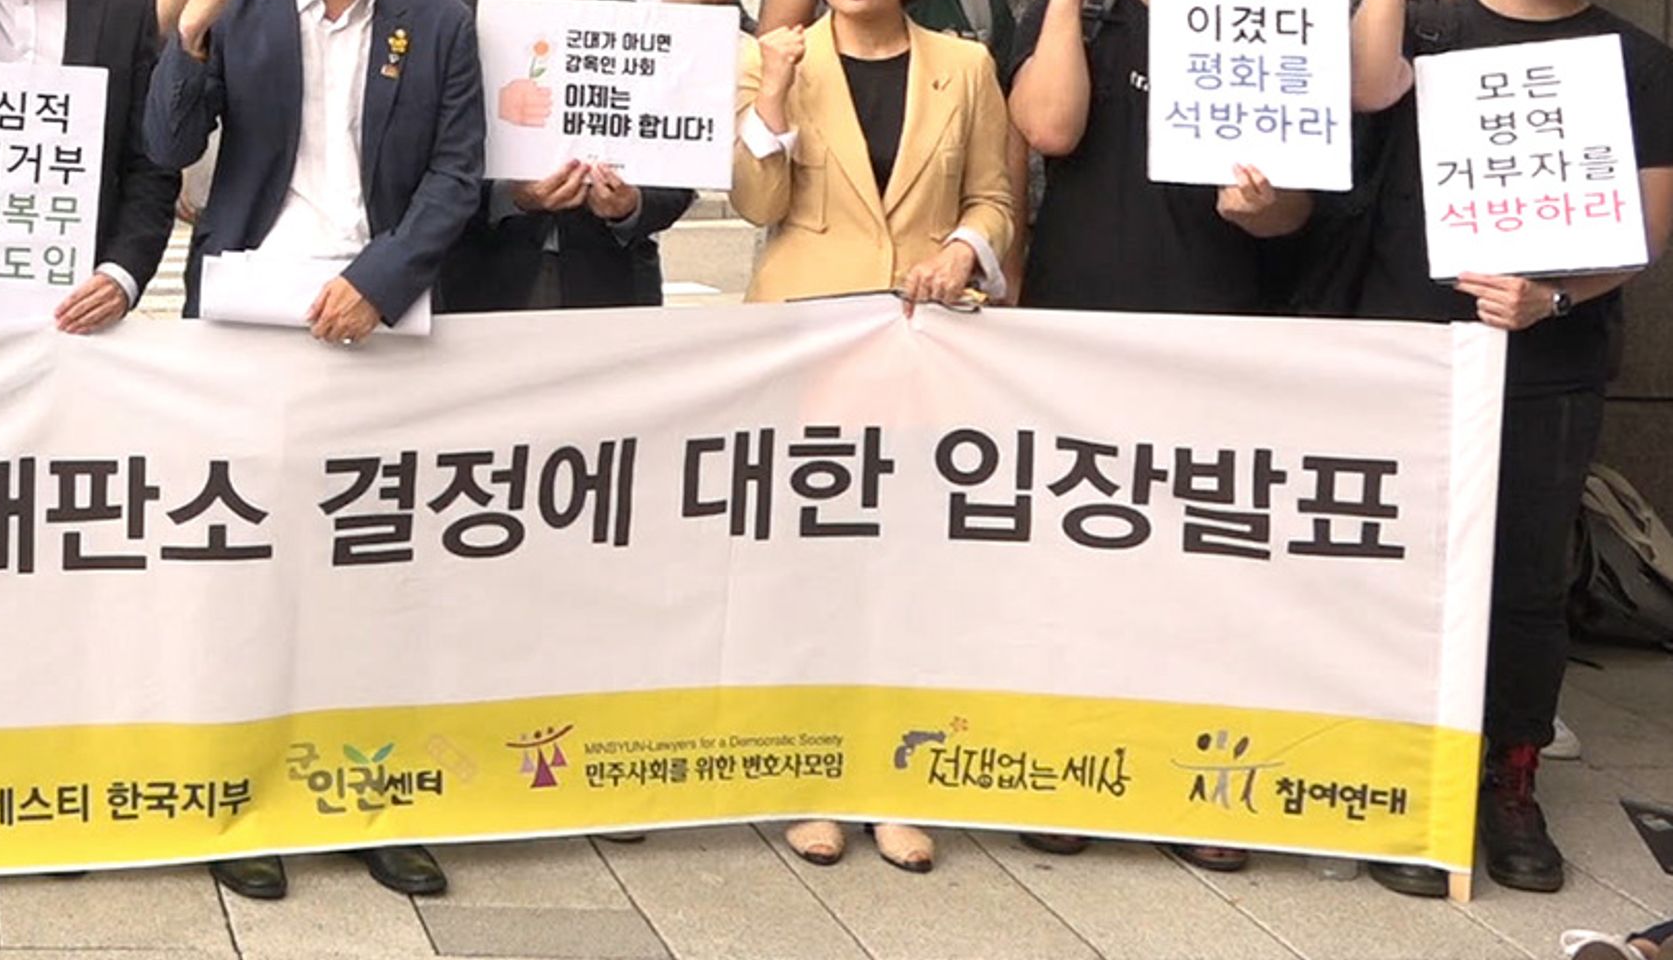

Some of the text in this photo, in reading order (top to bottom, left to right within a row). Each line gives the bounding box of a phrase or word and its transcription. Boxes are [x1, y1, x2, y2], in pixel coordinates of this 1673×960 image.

[566, 29, 671, 53] 군대가 아니면
[1187, 4, 1314, 45] 이겼다
[566, 54, 655, 76] 감옥인 사회
[1187, 52, 1313, 95] 평화를
[1476, 65, 1561, 100] 모든
[564, 83, 631, 110] 이제는
[562, 111, 714, 141] 바꿔야 합니다!
[1165, 101, 1338, 145] 석방하라
[1480, 107, 1565, 145] 병역
[1436, 145, 1618, 190] 거부자를
[1441, 189, 1626, 234] 석방하라
[318, 438, 637, 567] 결정에
[682, 426, 895, 540] 대한
[935, 428, 1405, 560] 입장발표
[307, 764, 443, 814] 인권센터
[585, 752, 843, 788] 민주사회를 위한 변호사모임
[107, 779, 252, 821] 한국지부
[1275, 776, 1407, 820] 참여연대
